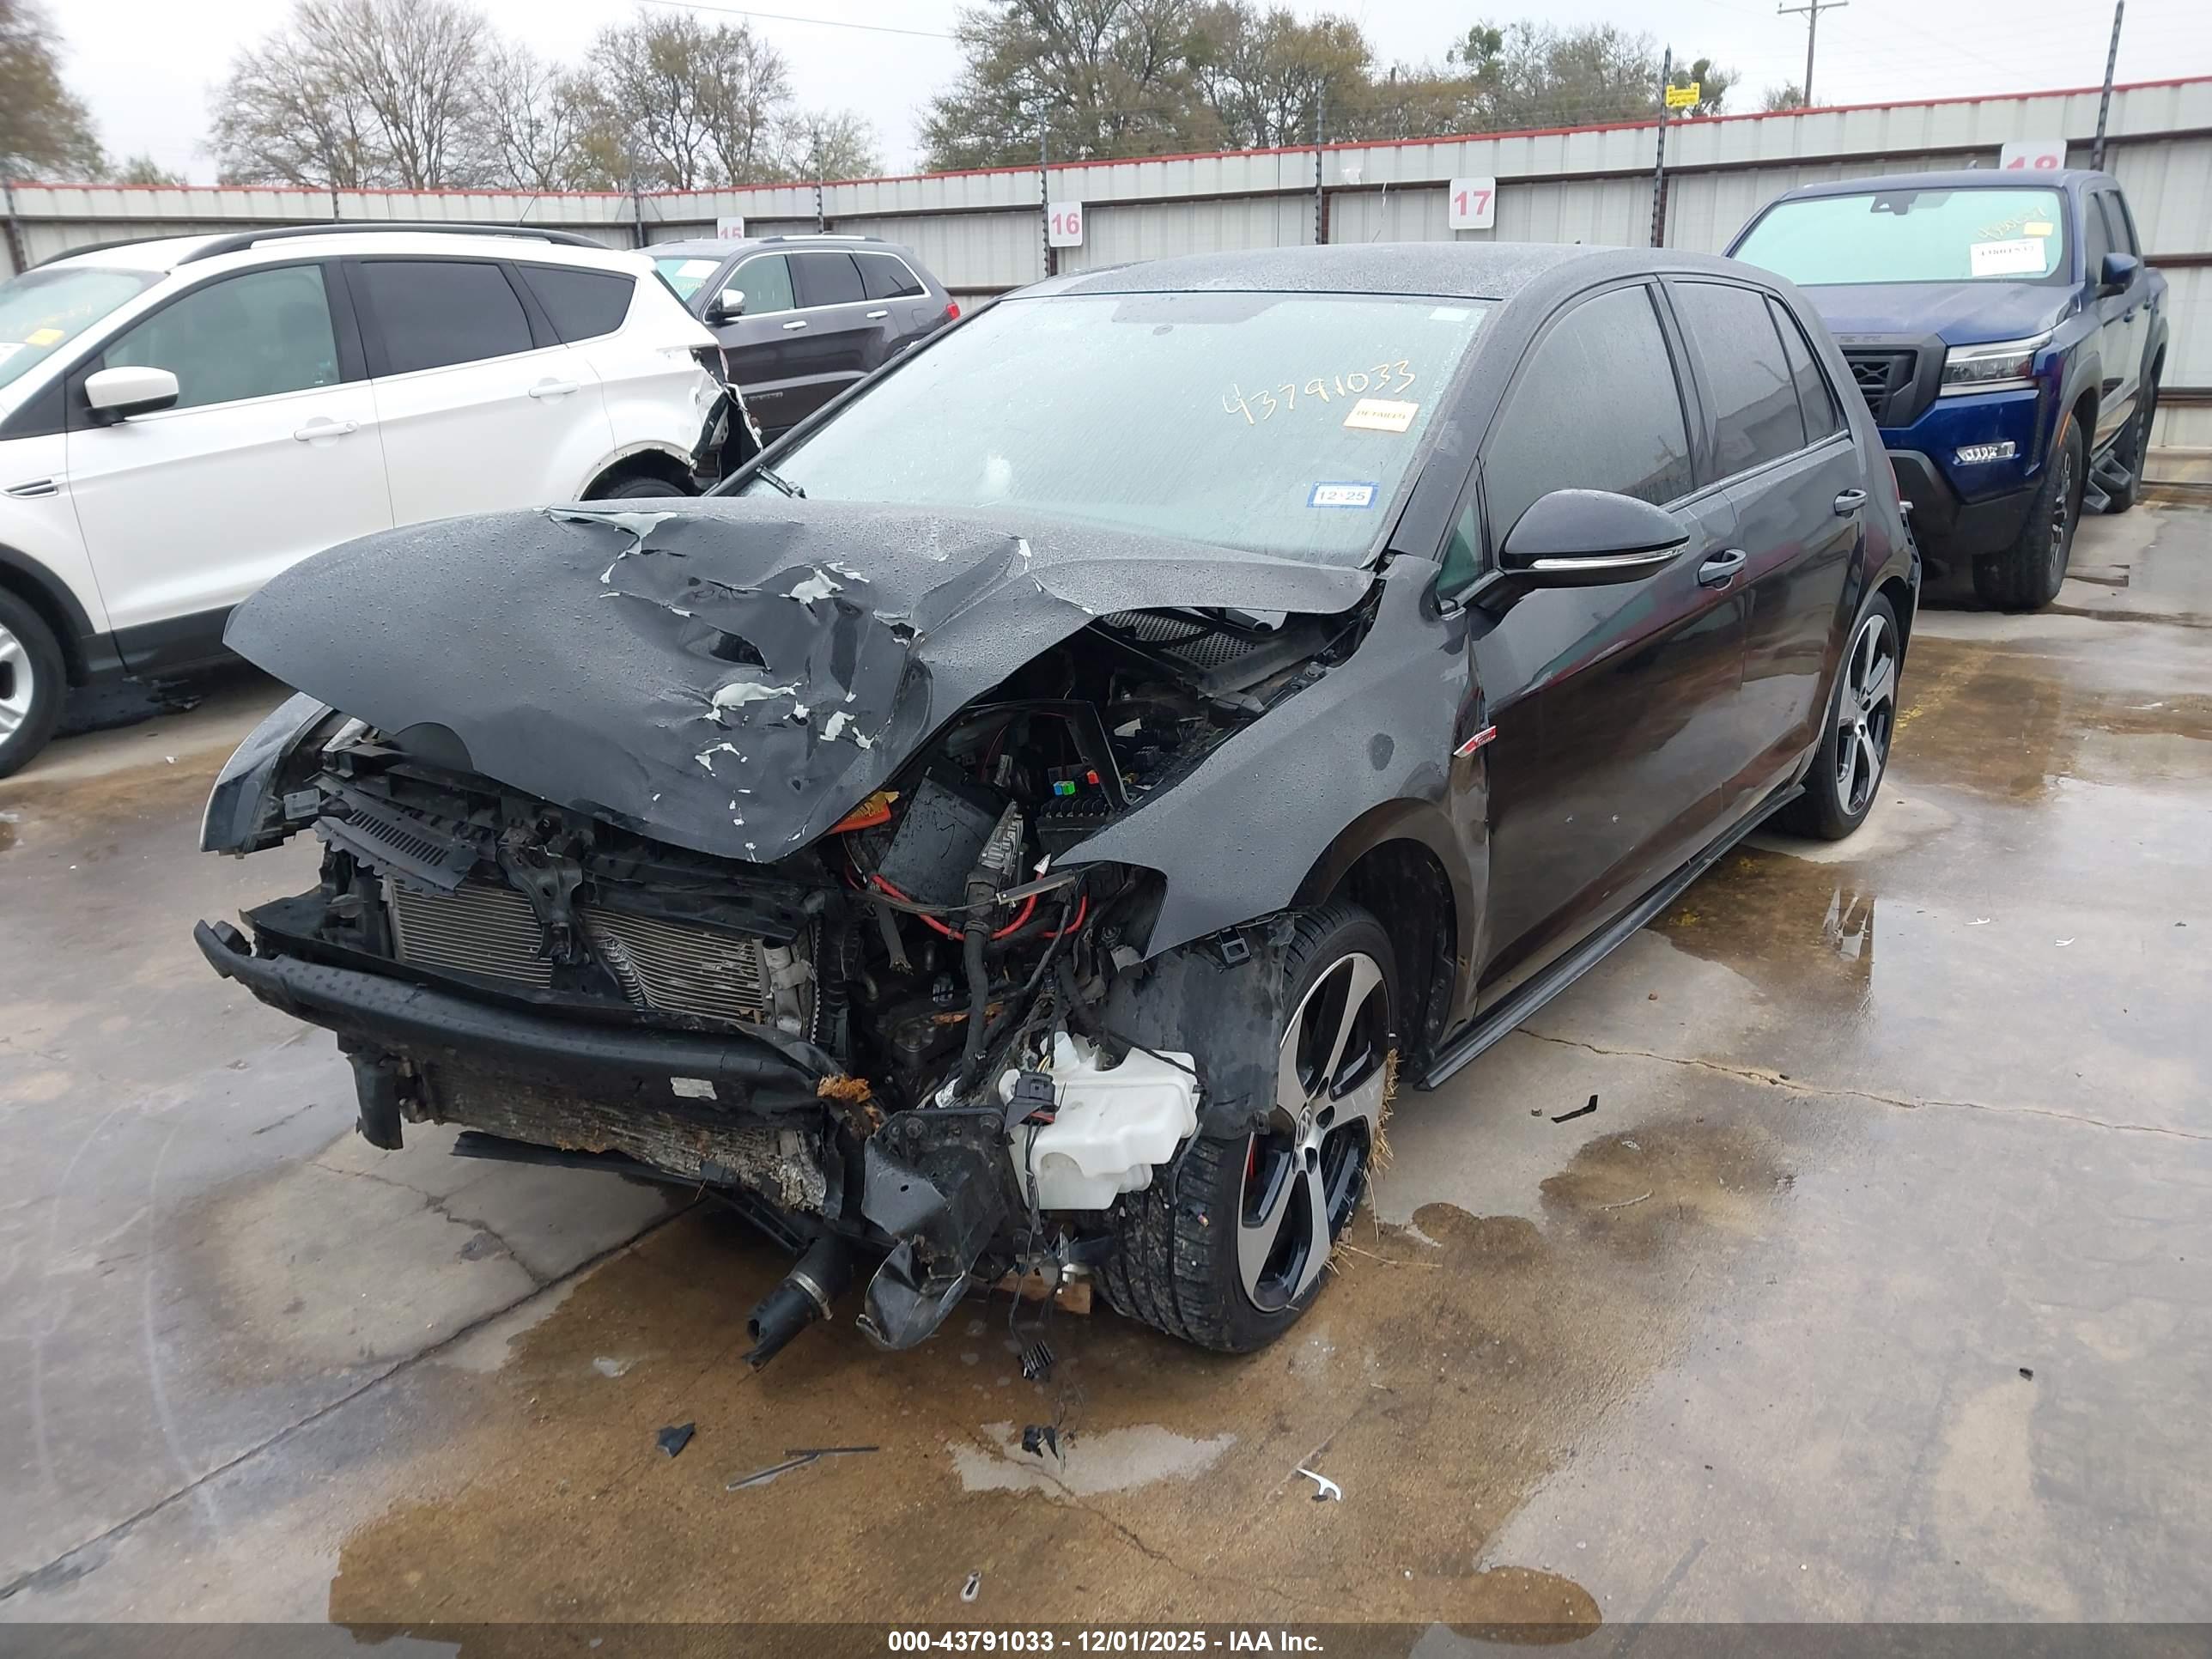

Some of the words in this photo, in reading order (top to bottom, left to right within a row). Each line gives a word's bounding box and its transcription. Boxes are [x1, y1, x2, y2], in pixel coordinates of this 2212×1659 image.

[1454, 190, 1492, 216] 17
[1052, 213, 1080, 234] 16
[1222, 360, 1416, 425] 43791033
